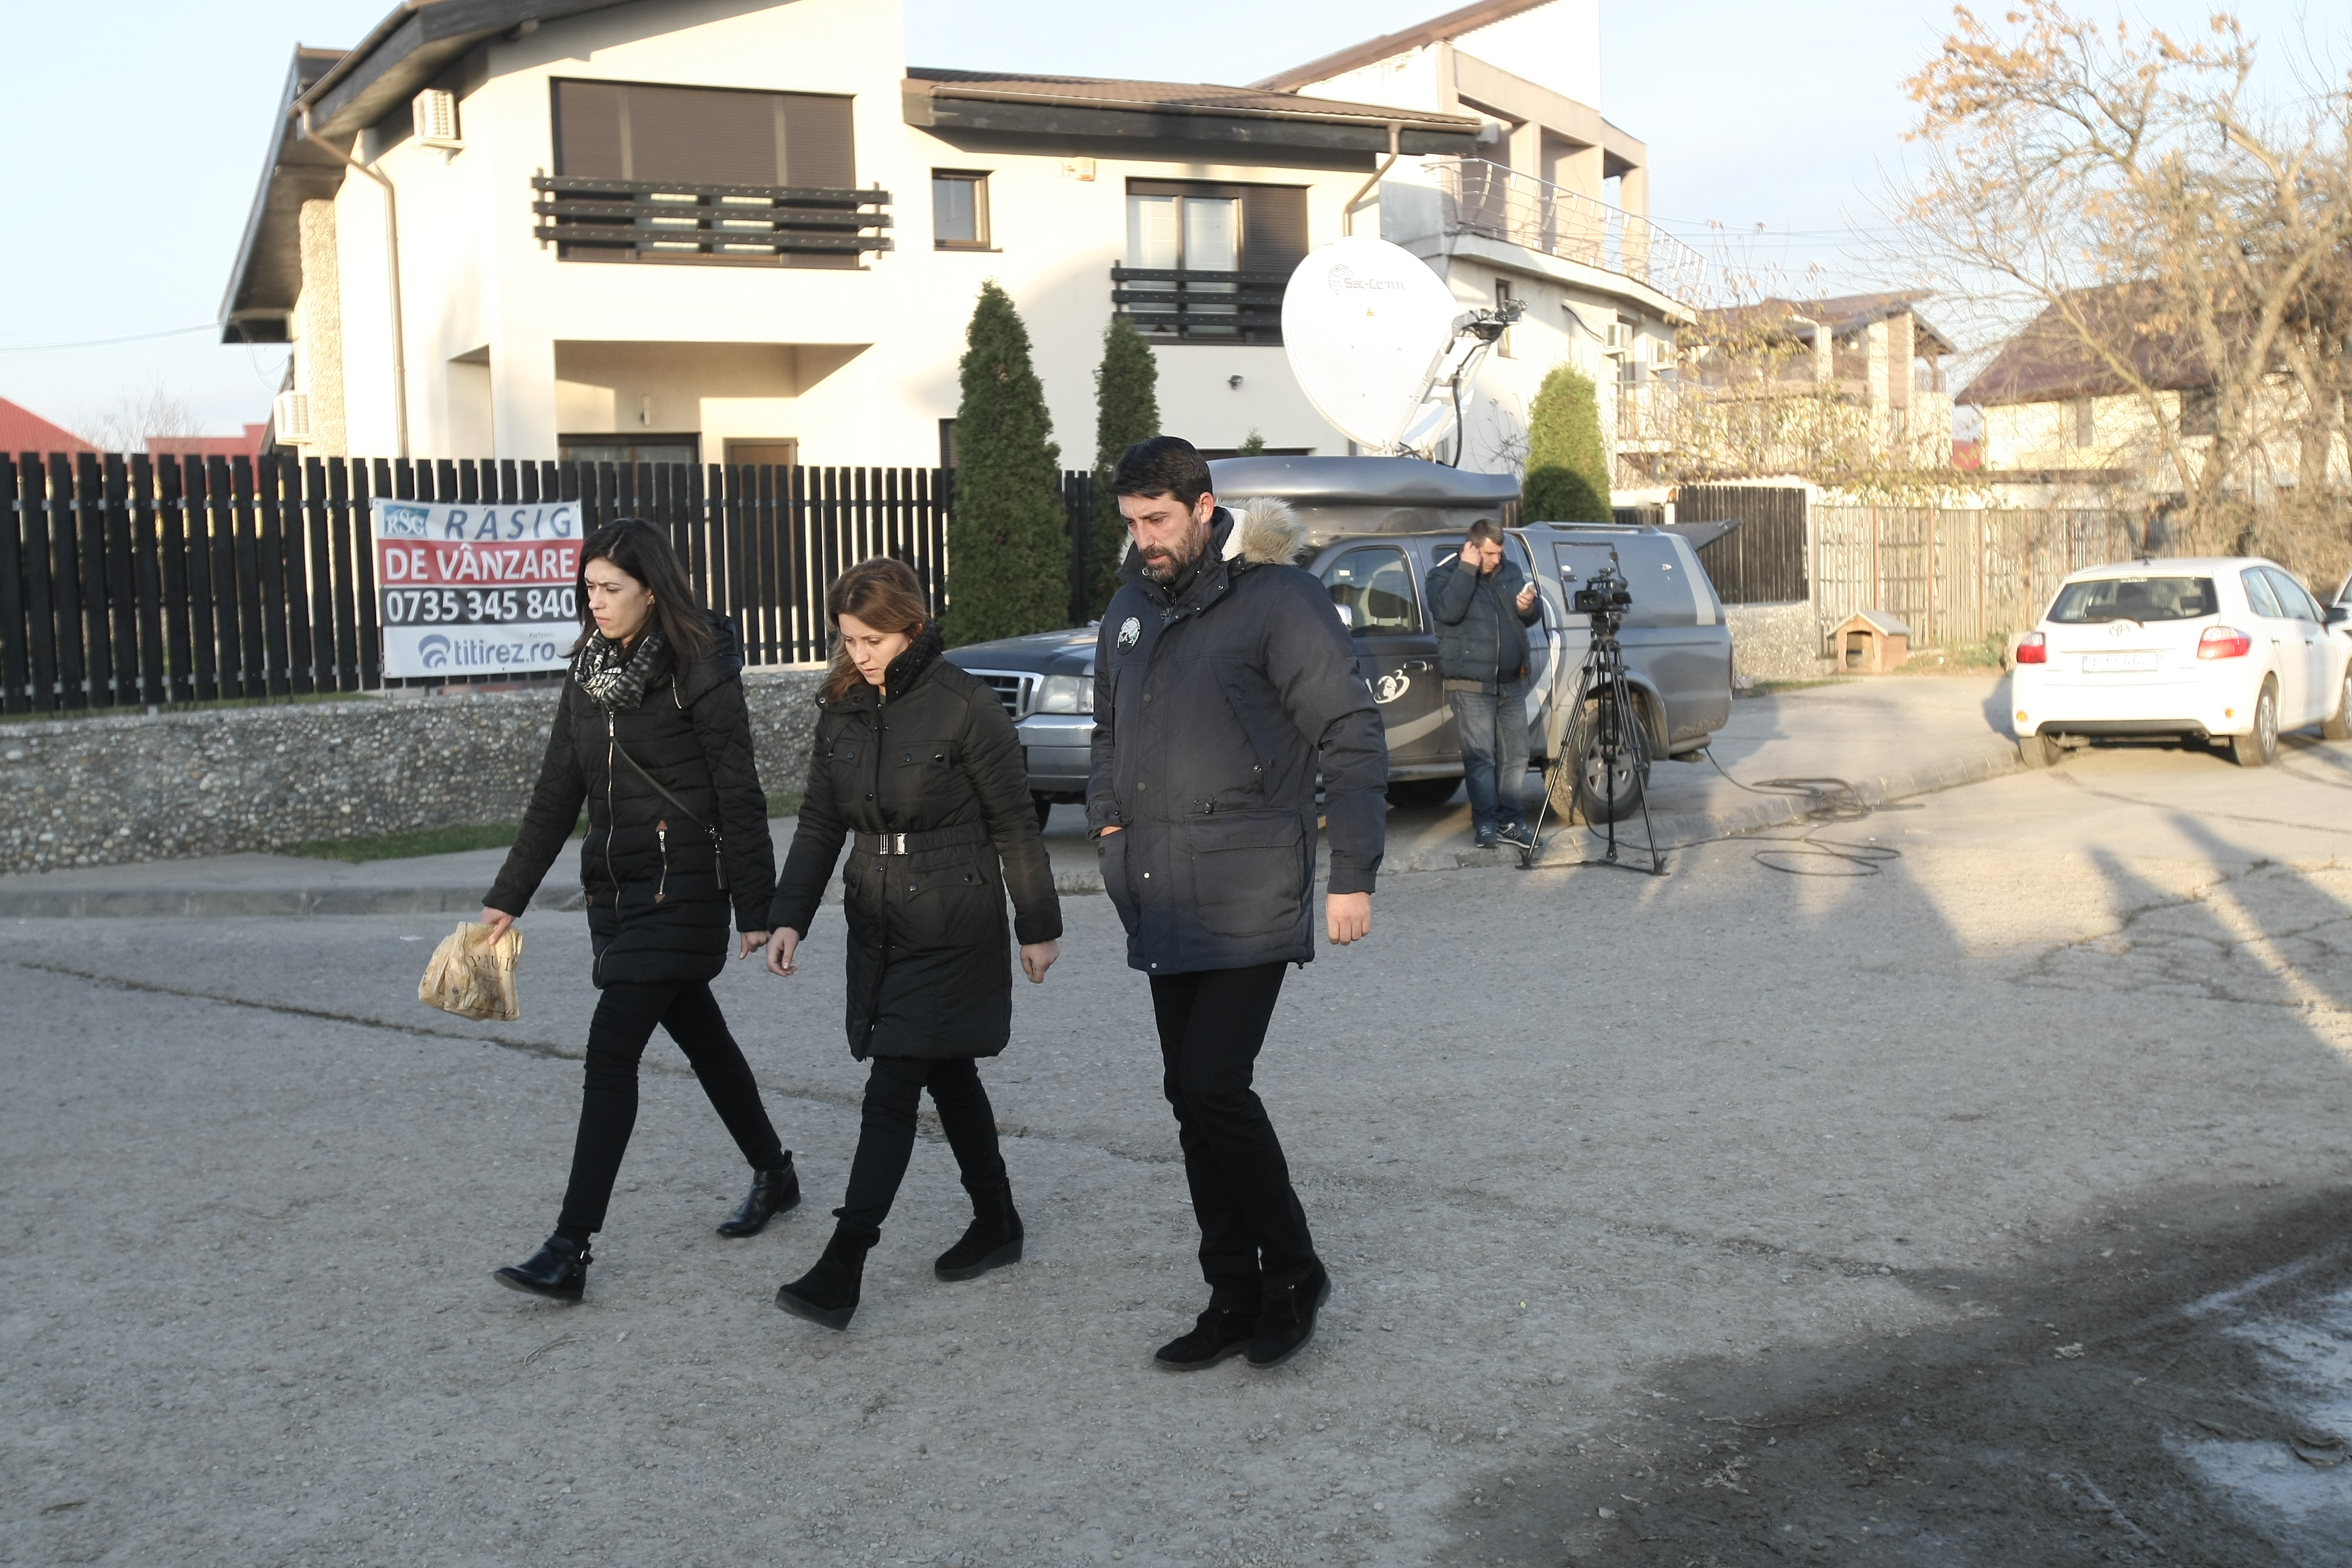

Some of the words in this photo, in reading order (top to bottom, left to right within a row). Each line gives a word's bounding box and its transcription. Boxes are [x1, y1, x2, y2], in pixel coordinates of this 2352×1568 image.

[385, 509, 425, 535] RSG
[443, 507, 572, 540] RASIG
[385, 548, 428, 581] DE
[436, 543, 576, 581] VÂNZARE
[386, 589, 460, 622] 0735
[466, 589, 518, 622] 345
[526, 589, 577, 619] 840
[453, 639, 556, 665] titirez.ro
[469, 955, 514, 972] PAUL
